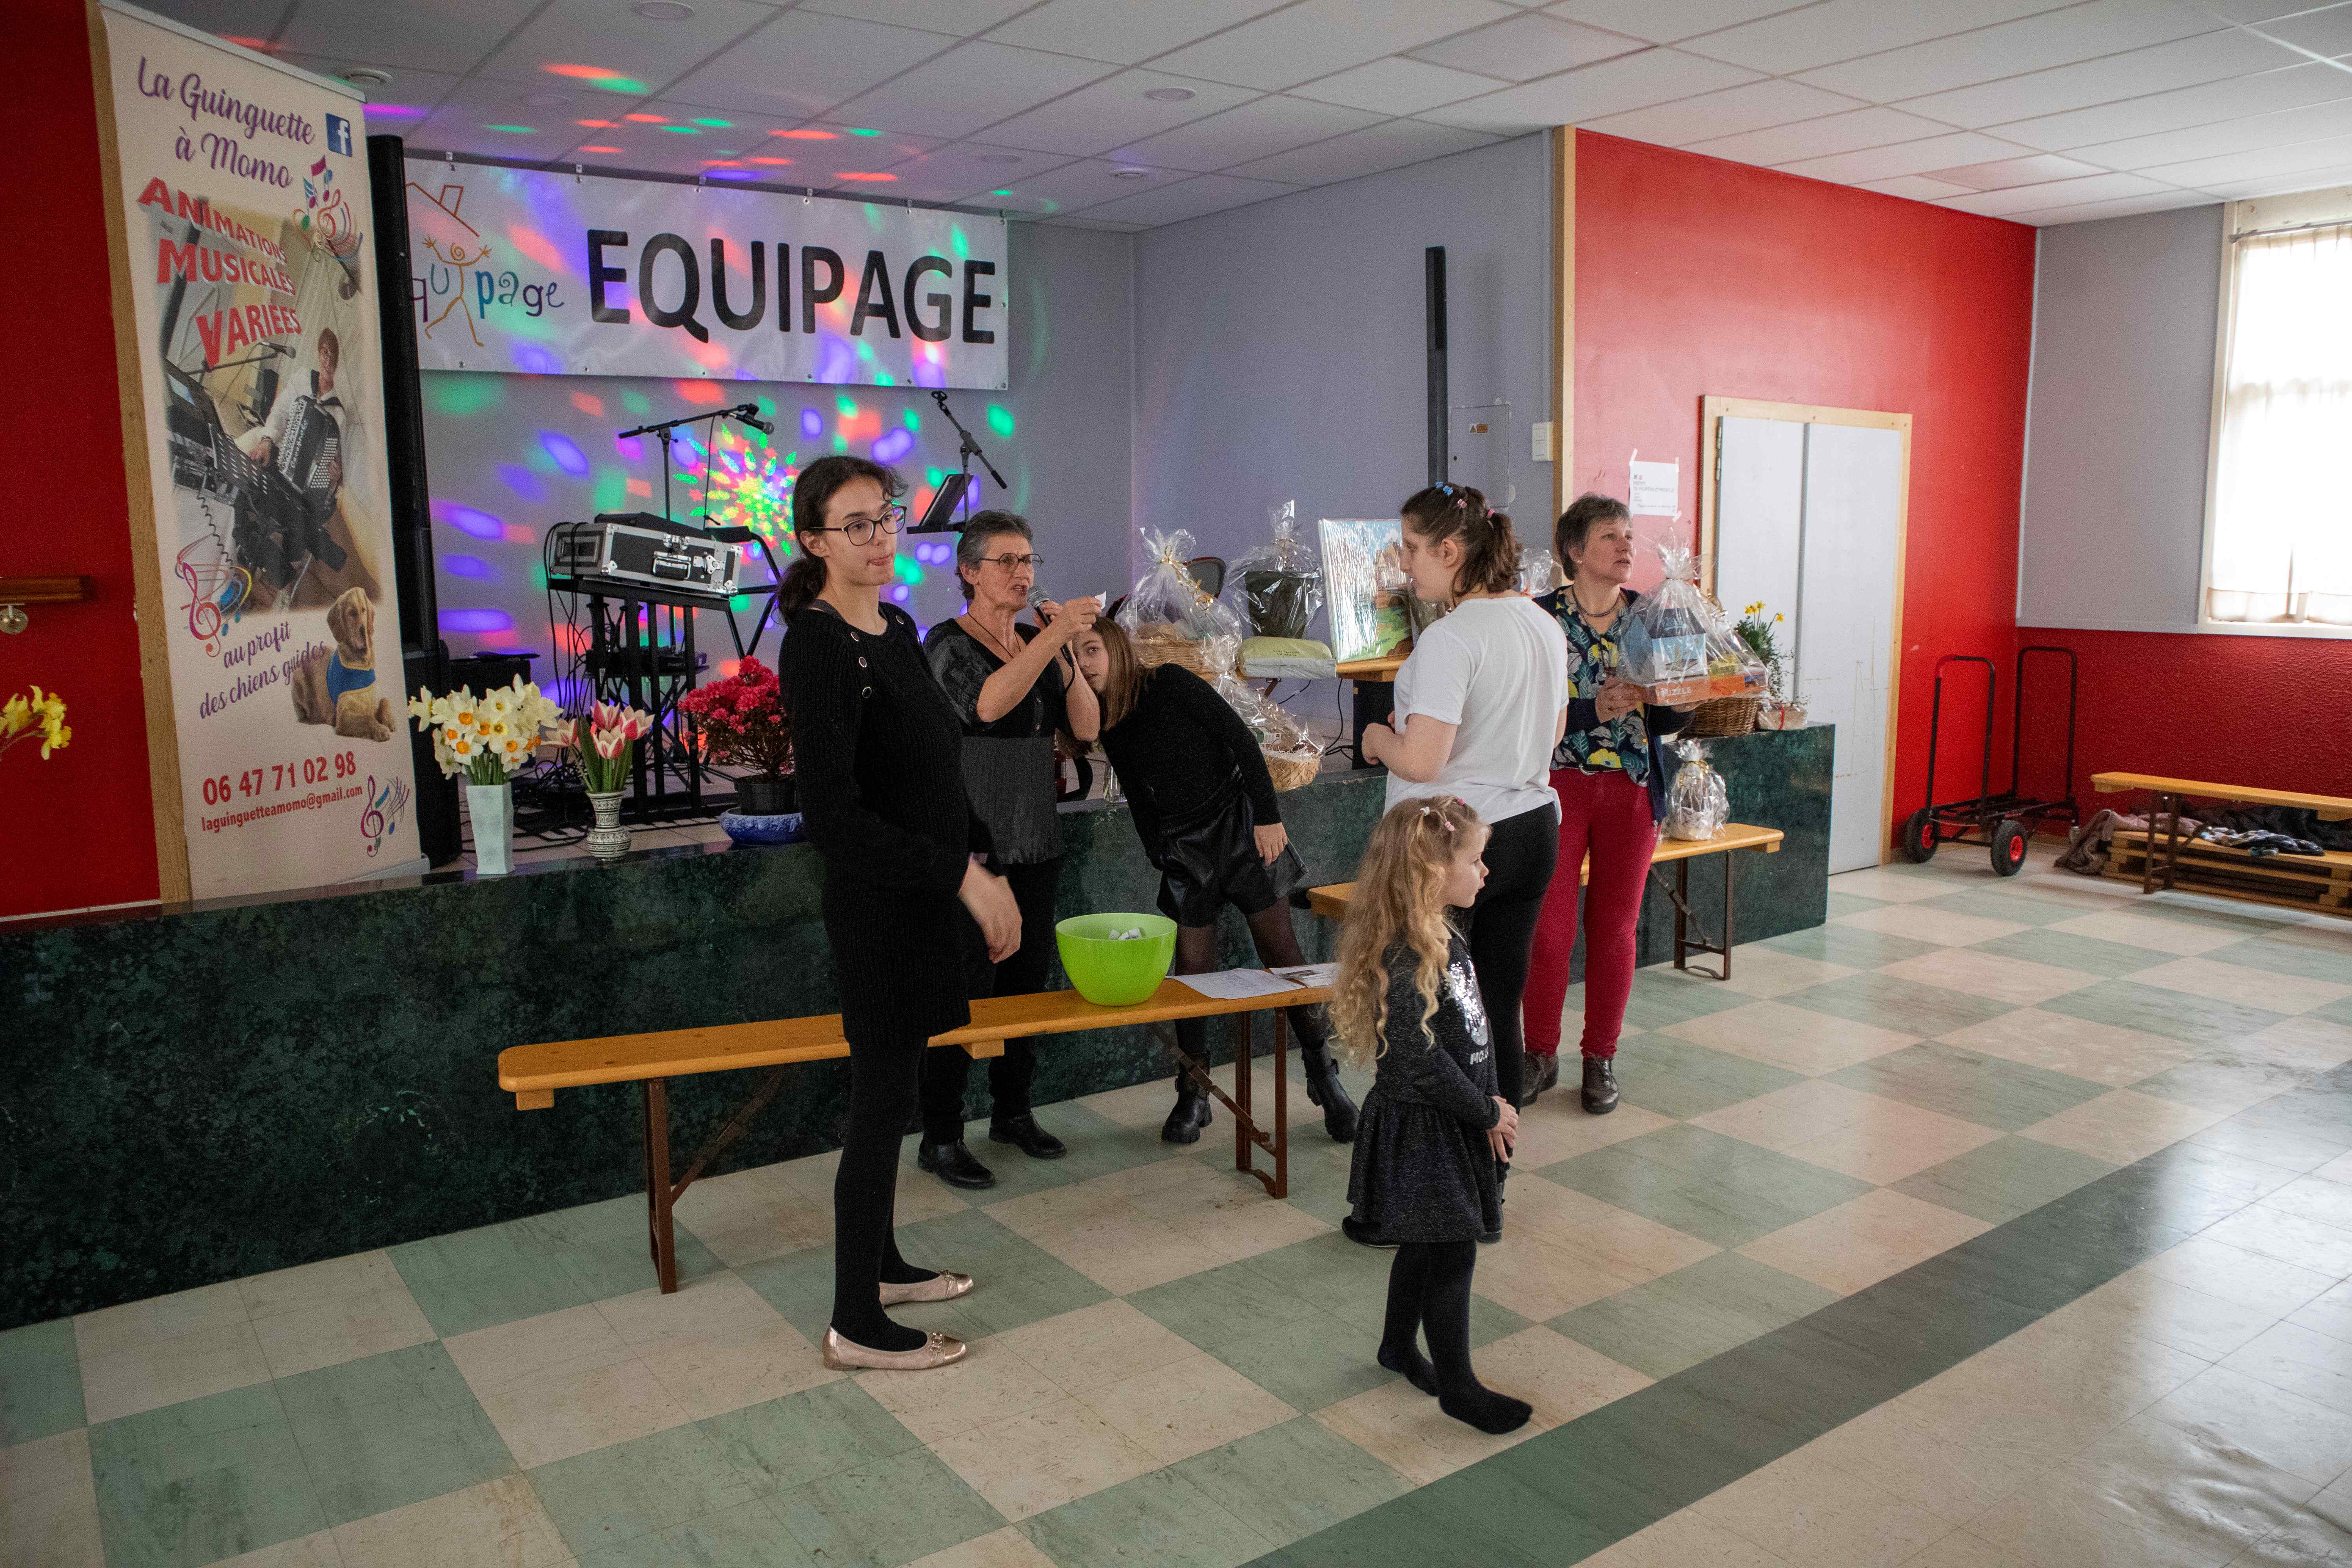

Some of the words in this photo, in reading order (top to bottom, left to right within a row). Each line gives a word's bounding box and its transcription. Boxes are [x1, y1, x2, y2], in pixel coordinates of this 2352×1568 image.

[138, 56, 175, 100] La
[180, 73, 315, 145] Guinguette
[175, 125, 195, 162] à
[201, 132, 293, 188] Momo
[138, 176, 288, 264] ANIMATIONS
[157, 238, 296, 296] MUSICALES
[587, 229, 996, 344] EQUIPAGE
[196, 305, 302, 368] VARIEES
[224, 646, 246, 668] au
[247, 621, 291, 666] profit
[200, 691, 227, 719] des
[229, 665, 280, 703] chiens
[282, 641, 326, 686] guides
[201, 785, 363, 833] laguinguetteamomo@gmail.com
[202, 775, 231, 806] 06
[238, 768, 263, 797] 47
[272, 762, 296, 791] 71
[303, 756, 328, 784] 02
[334, 751, 356, 778] 98
